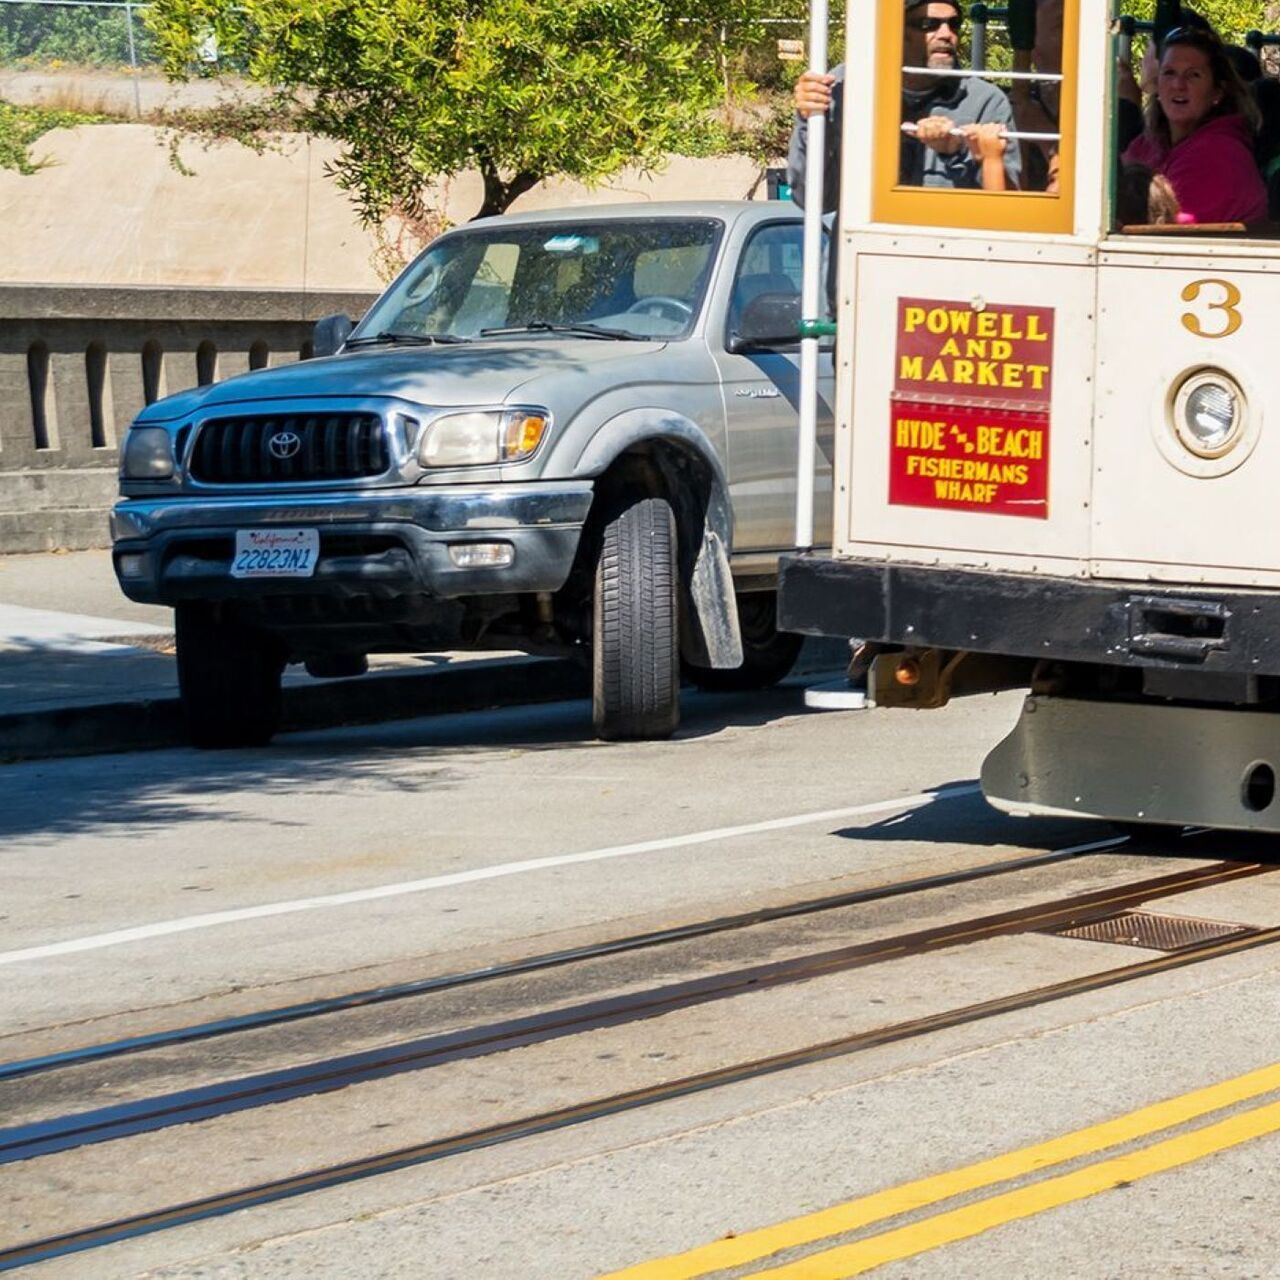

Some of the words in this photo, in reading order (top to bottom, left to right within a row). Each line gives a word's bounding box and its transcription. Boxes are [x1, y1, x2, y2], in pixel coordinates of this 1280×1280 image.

[904, 306, 1048, 341] POWELL
[1180, 278, 1243, 339] 3
[940, 338, 1012, 360] AND
[900, 356, 1049, 389] MARKET
[896, 419, 946, 450] HYDE
[976, 426, 1043, 459] BEACH
[906, 455, 1029, 485] FISHERMANS
[935, 480, 998, 503] WHARF
[236, 548, 312, 571] 22823N1
